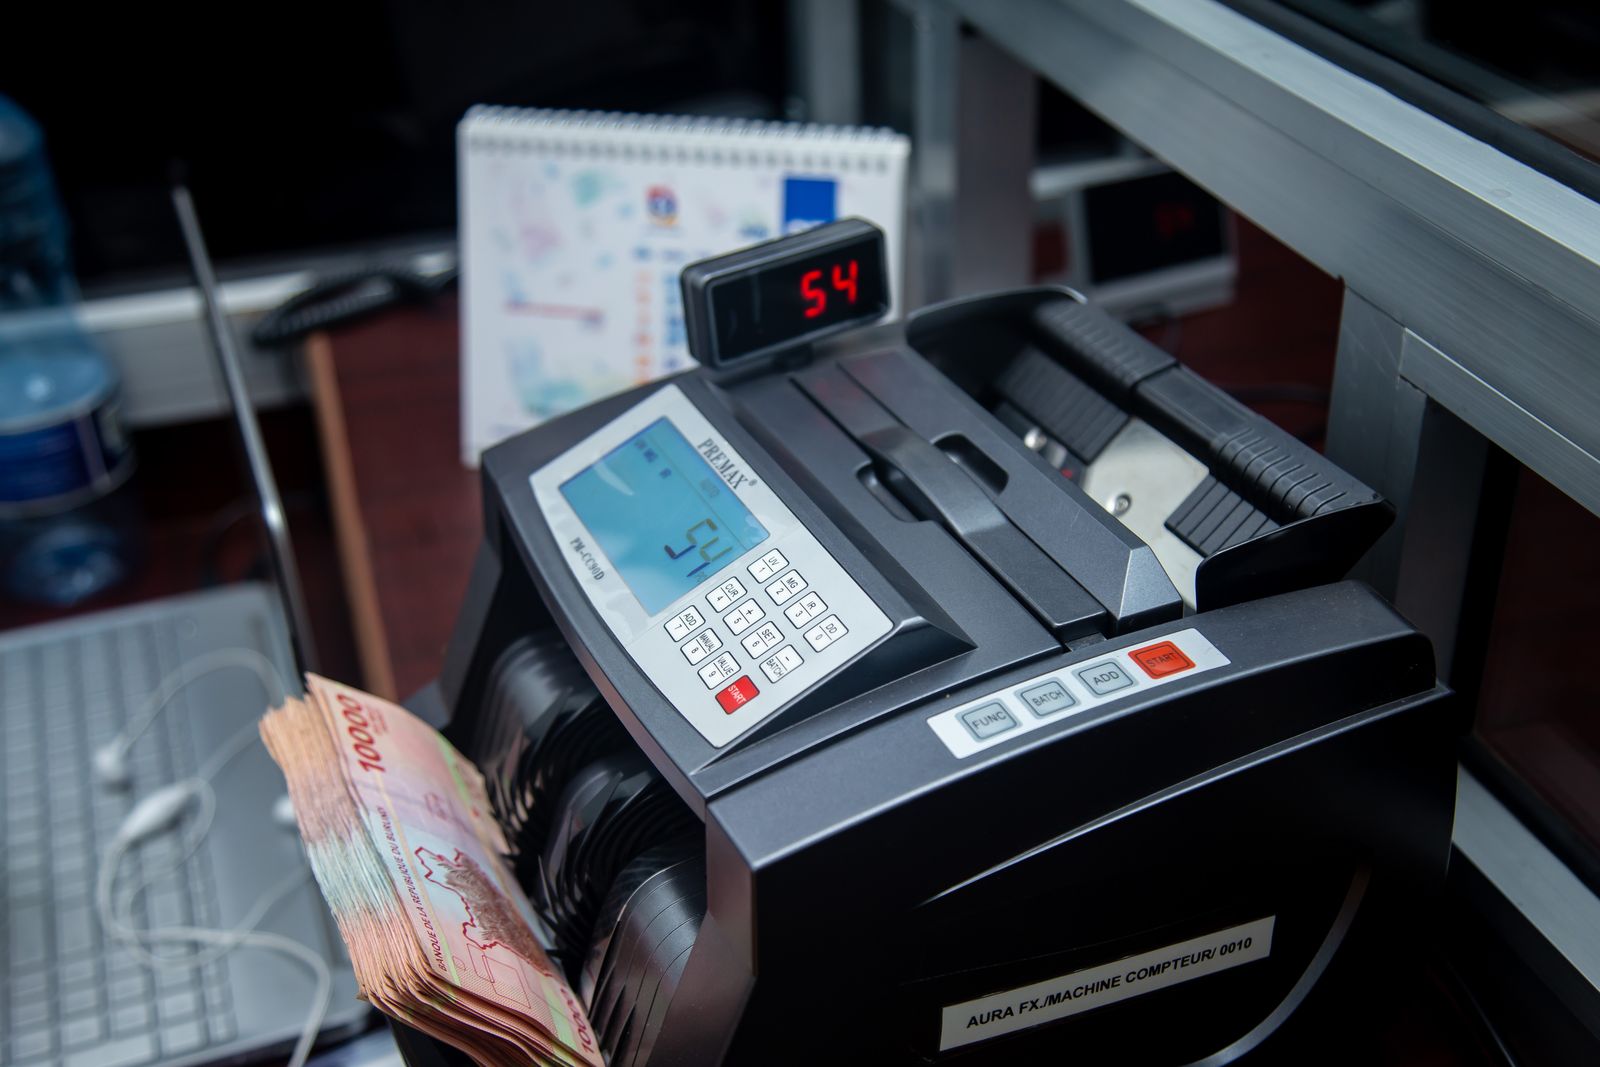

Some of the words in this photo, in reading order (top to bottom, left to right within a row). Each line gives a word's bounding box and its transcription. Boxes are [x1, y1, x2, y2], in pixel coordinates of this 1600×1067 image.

[800, 260, 859, 319] 54
[697, 438, 749, 490] PREMAX
[664, 518, 734, 578] 54
[768, 556, 780, 567] UV
[725, 583, 739, 598] CUR
[786, 577, 799, 589] MG
[776, 588, 785, 596] 2
[806, 600, 817, 610] IR
[683, 613, 698, 626] ADD
[733, 617, 742, 625] 5
[795, 610, 804, 618] 3
[761, 628, 776, 642] SET
[825, 623, 838, 635] DD
[690, 646, 699, 654] 8
[699, 632, 716, 653] MANUAL
[752, 640, 760, 648] 6
[717, 656, 735, 676] VALUE
[1146, 652, 1177, 668] START
[708, 670, 717, 678] 9
[766, 658, 785, 679] BATCH
[1092, 670, 1120, 686] ADD
[727, 684, 747, 705] START
[1031, 690, 1065, 707] BATCH
[971, 711, 1007, 730] FUNC
[336, 693, 386, 773] 10000
[416, 906, 427, 917] LA
[421, 918, 432, 930] DE
[427, 930, 447, 971] BANQUE
[966, 1005, 1015, 1029] AURA
[1018, 975, 1122, 1015] FX./MACHINE
[1125, 947, 1218, 984] COMPTEUR/
[1219, 937, 1253, 956] 0010
